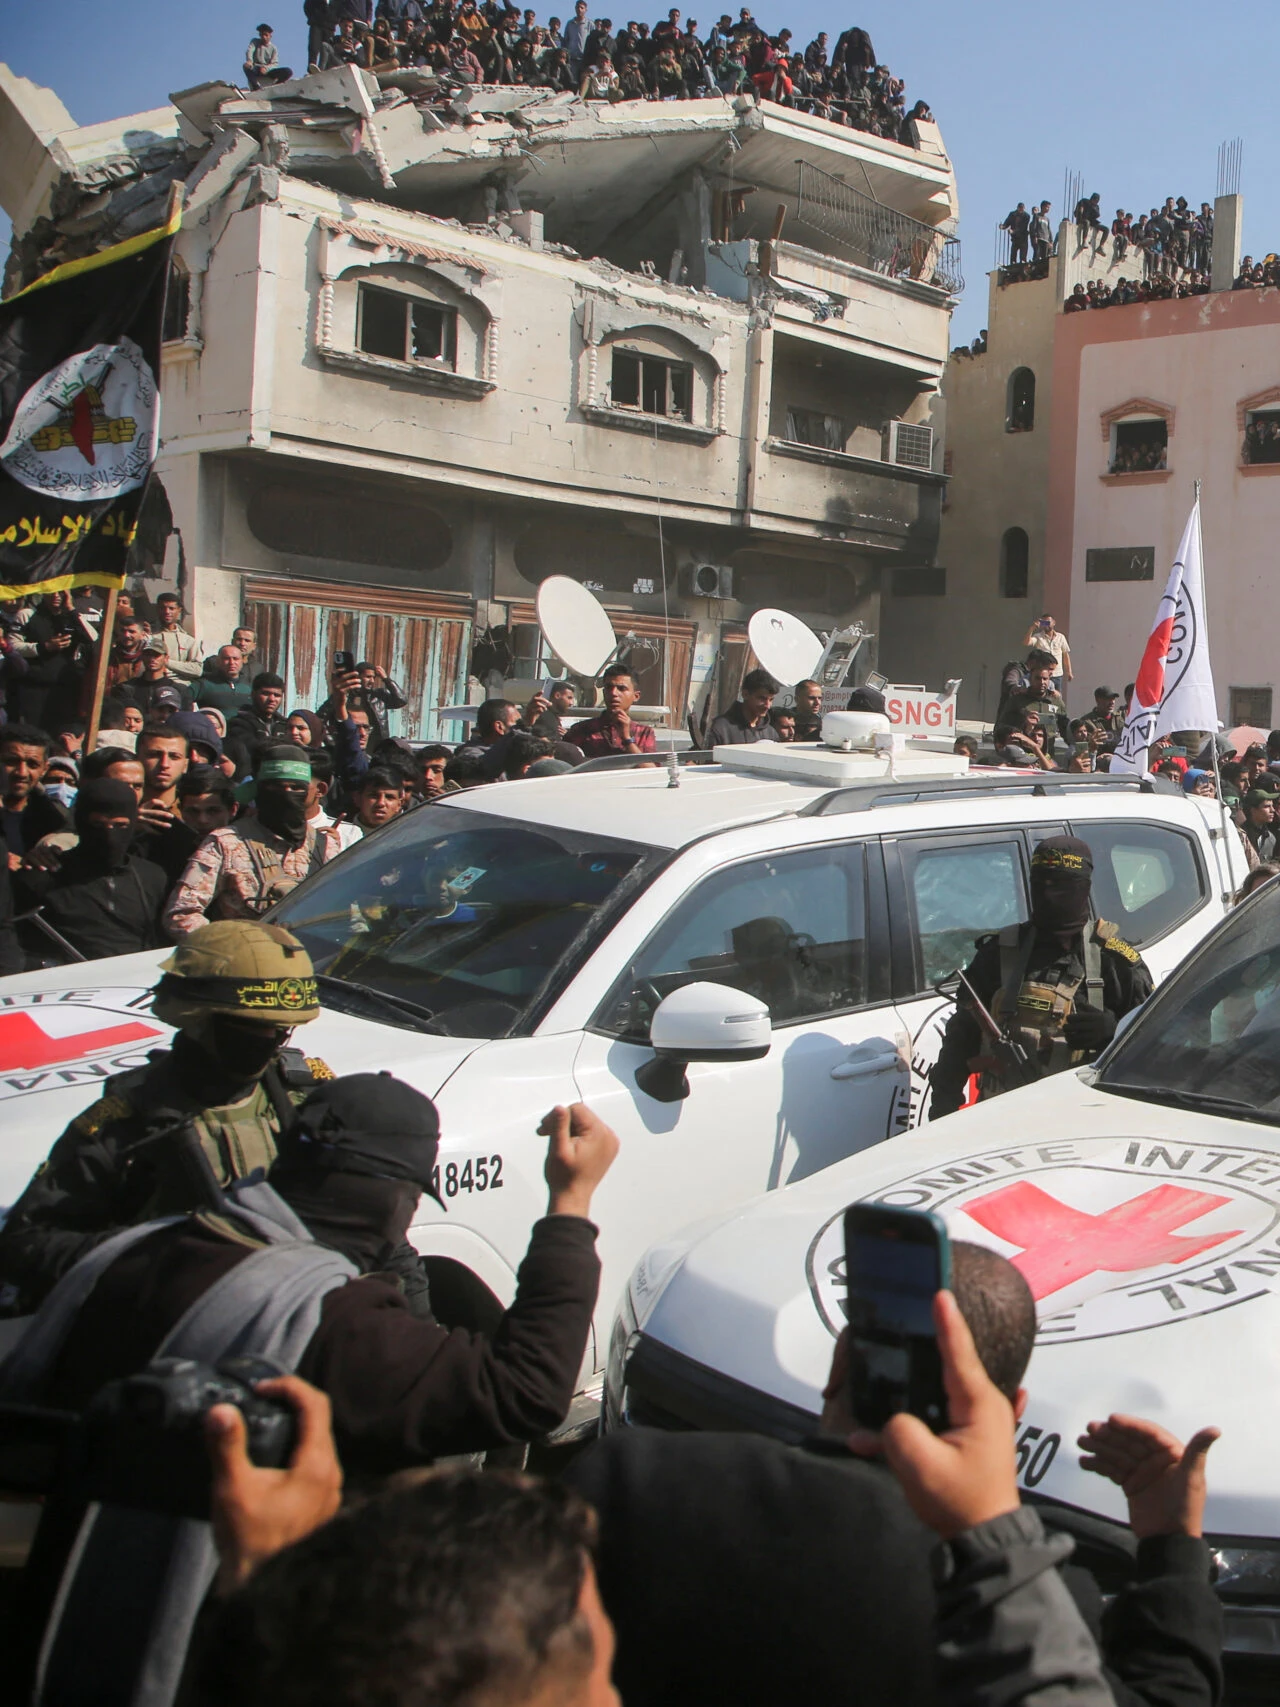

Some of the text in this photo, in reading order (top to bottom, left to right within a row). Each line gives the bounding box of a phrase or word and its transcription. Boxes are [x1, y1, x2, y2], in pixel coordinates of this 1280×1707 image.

[888, 699, 954, 727] SNG1
[2, 990, 101, 1006] ITE
[433, 1154, 503, 1197] 18452
[872, 1143, 1082, 1208] OMITE
